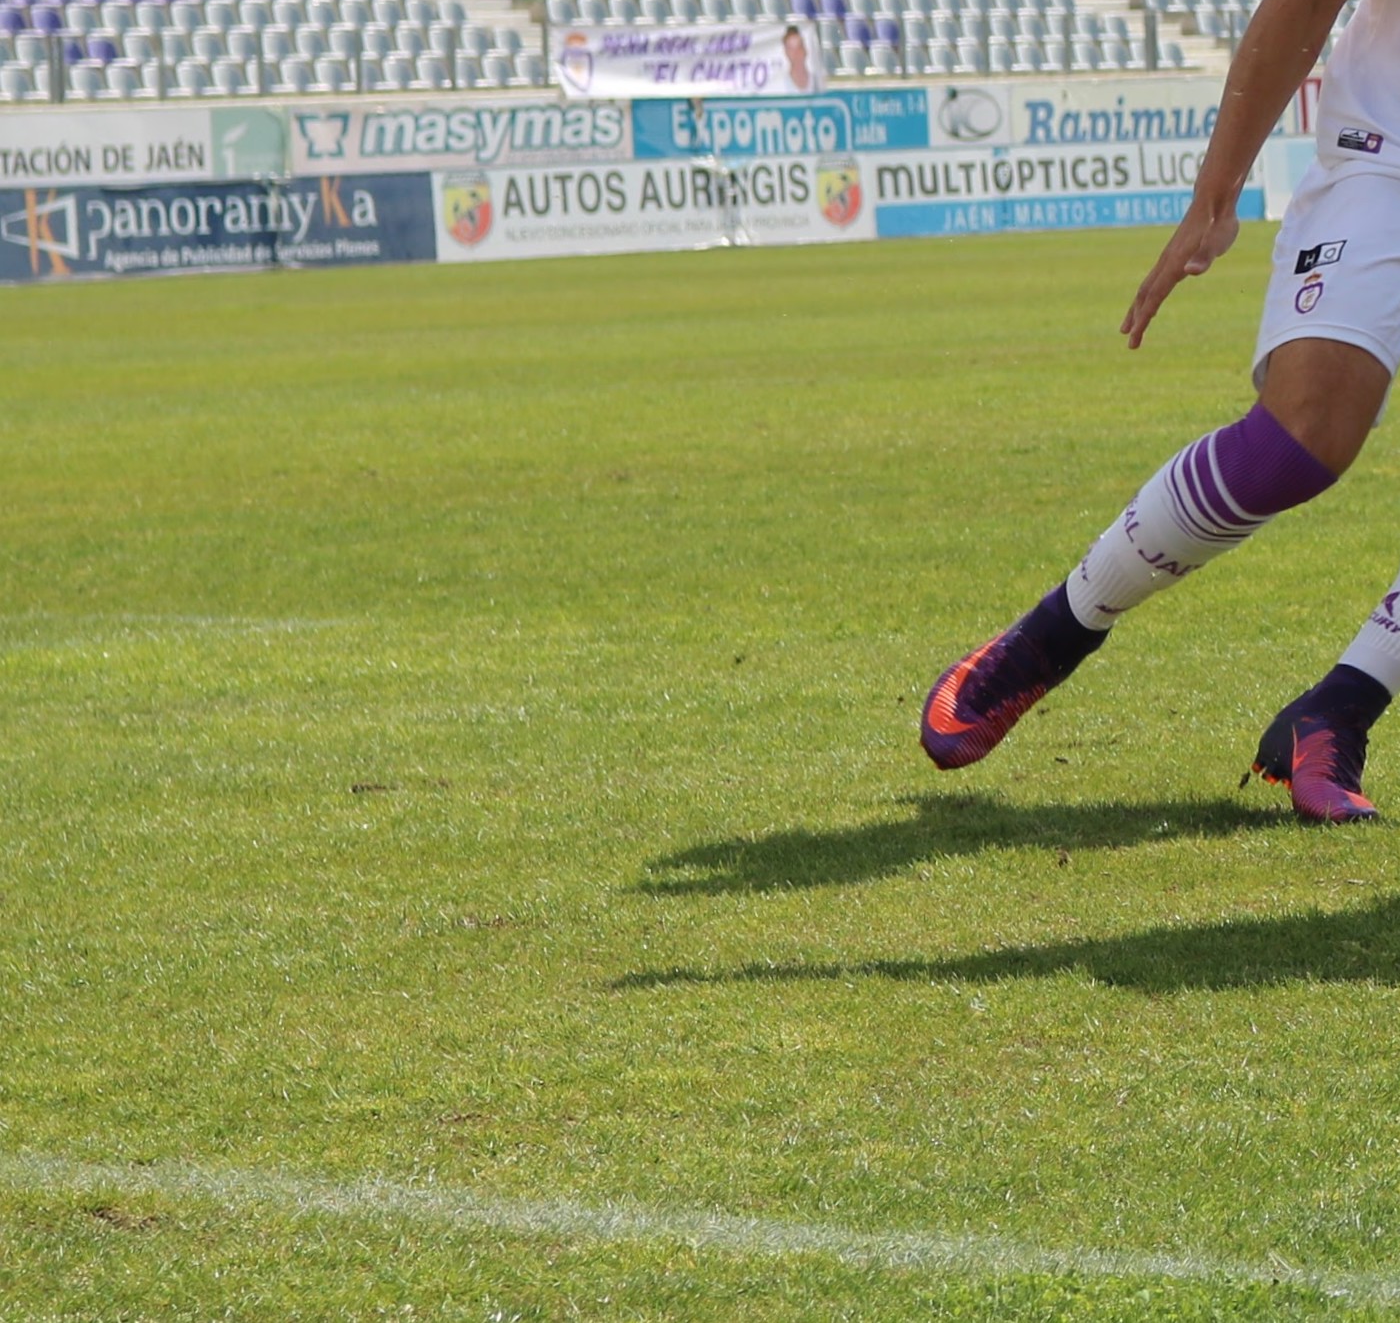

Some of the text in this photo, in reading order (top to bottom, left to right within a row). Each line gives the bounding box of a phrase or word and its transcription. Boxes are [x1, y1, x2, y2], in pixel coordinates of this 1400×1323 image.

[359, 103, 625, 164] masymas
[1024, 95, 1219, 145] Rapimue
[103, 145, 135, 173] DE
[143, 137, 205, 172] JAÉN
[503, 171, 627, 217] AUTOS
[944, 202, 996, 230] JAÉN
[1015, 199, 1098, 228] MARTOS
[104, 248, 159, 273] Agencia
[160, 246, 179, 267] de
[181, 242, 252, 266] Publicidad
[335, 237, 380, 258] Plenos
